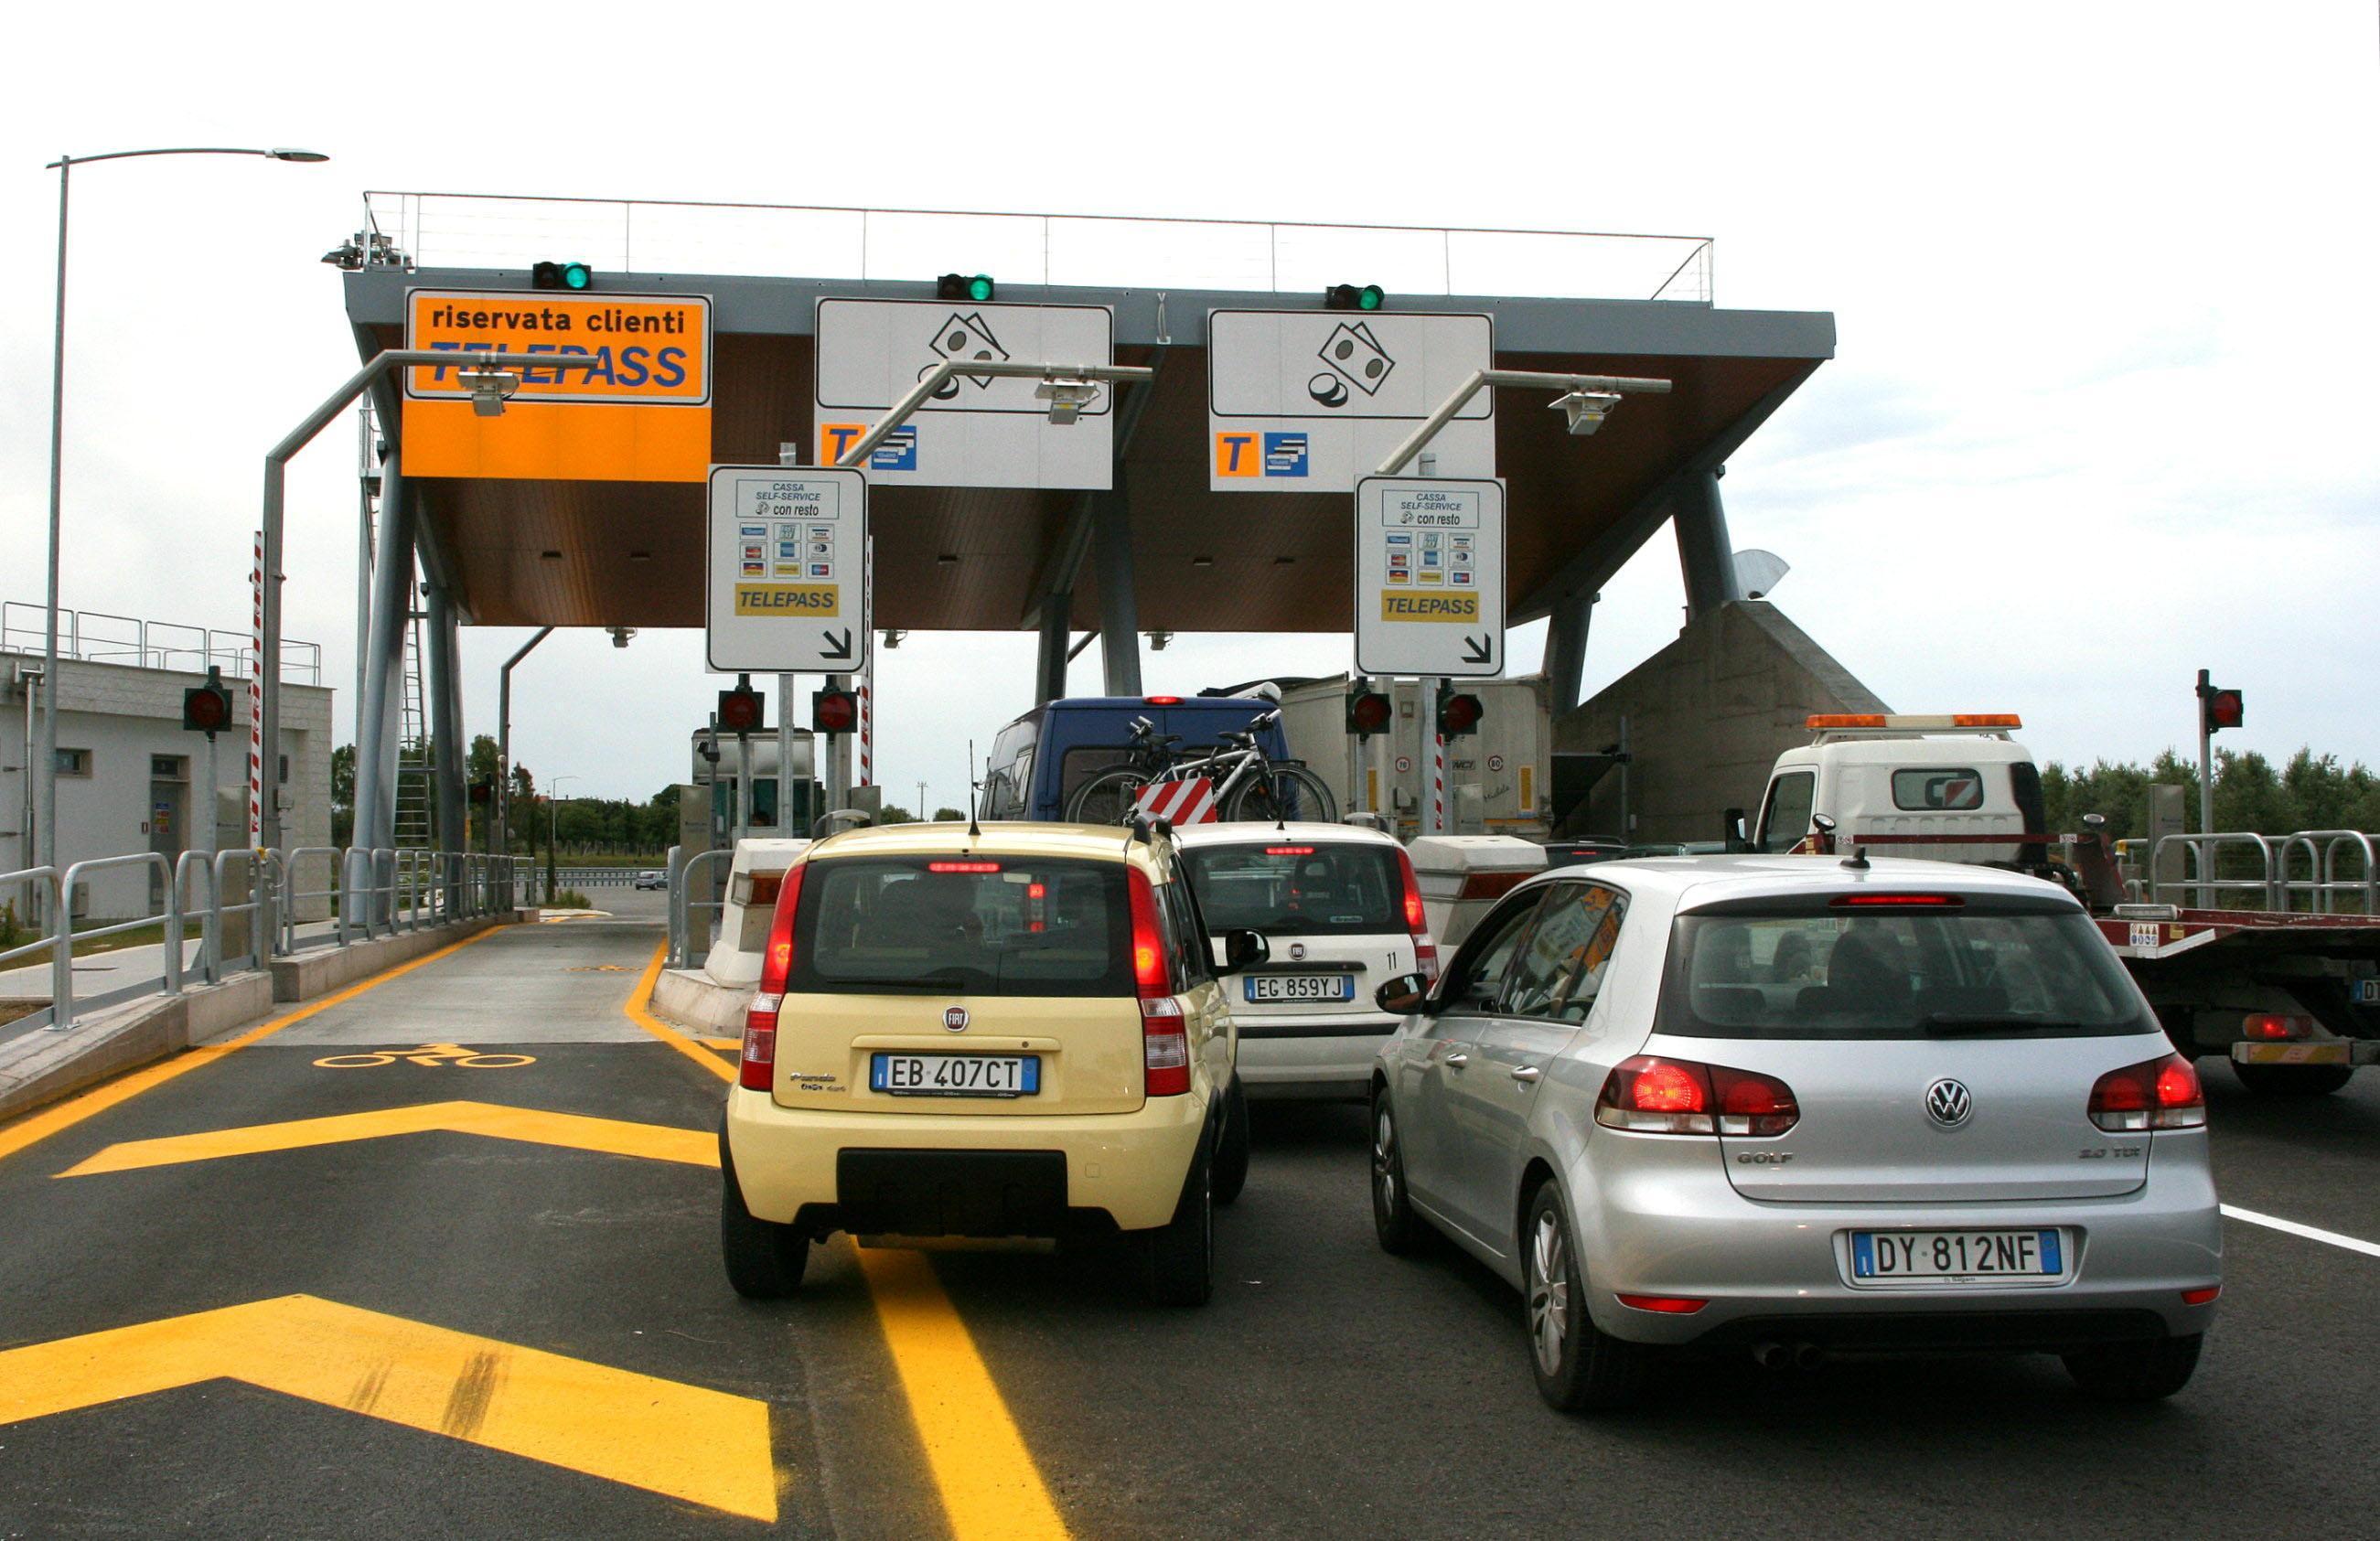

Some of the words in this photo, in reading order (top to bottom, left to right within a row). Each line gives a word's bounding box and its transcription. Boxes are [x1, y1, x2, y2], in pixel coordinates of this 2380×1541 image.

[432, 305, 572, 330] riservata
[586, 309, 684, 334] clienti
[829, 428, 859, 464] T
[1223, 436, 1251, 472] T
[773, 483, 805, 492] CASSA
[756, 492, 821, 501] SELF-SERVICE
[1416, 493, 1446, 502] CASSA
[773, 505, 791, 516] con
[794, 504, 820, 517] resto
[1400, 502, 1463, 511] SELF-SERVICE
[1418, 514, 1434, 524] con
[1437, 513, 1461, 525] resto
[740, 592, 834, 608] TELEPASS
[1386, 598, 1475, 615] TELEPASS
[1387, 951, 1397, 970] 11
[1257, 979, 1279, 998] EG
[1286, 978, 1341, 997] 859YJ
[948, 1012, 964, 1025] FIAT
[892, 1059, 924, 1086] EB
[934, 1059, 1019, 1088] 407CT
[1737, 1151, 1794, 1164] GOLF
[1877, 1236, 1915, 1272] DY
[1932, 1236, 2035, 1271] 812NF
